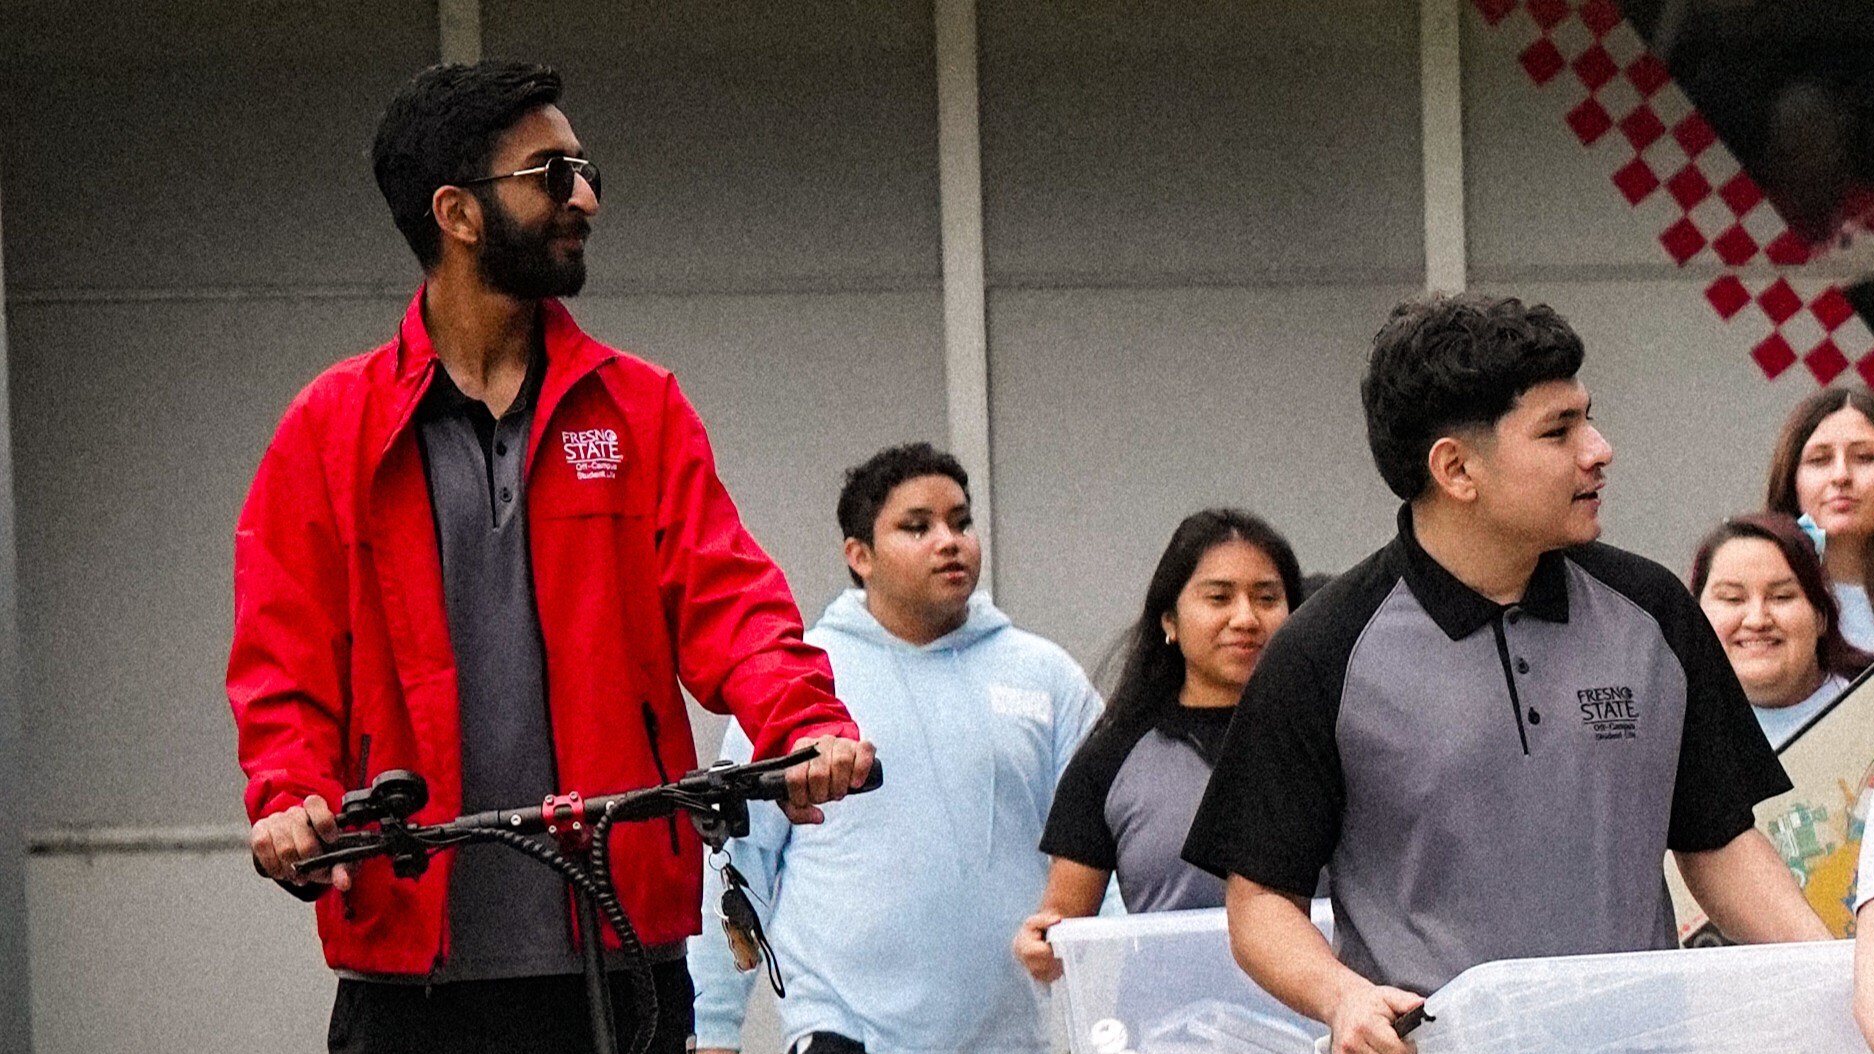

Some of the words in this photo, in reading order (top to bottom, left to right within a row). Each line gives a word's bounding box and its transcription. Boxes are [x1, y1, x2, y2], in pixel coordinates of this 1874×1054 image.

[561, 428, 618, 444] FRESNO
[563, 441, 624, 460] STATE
[1576, 686, 1633, 703] FRESNO
[1580, 700, 1640, 721] STATE
